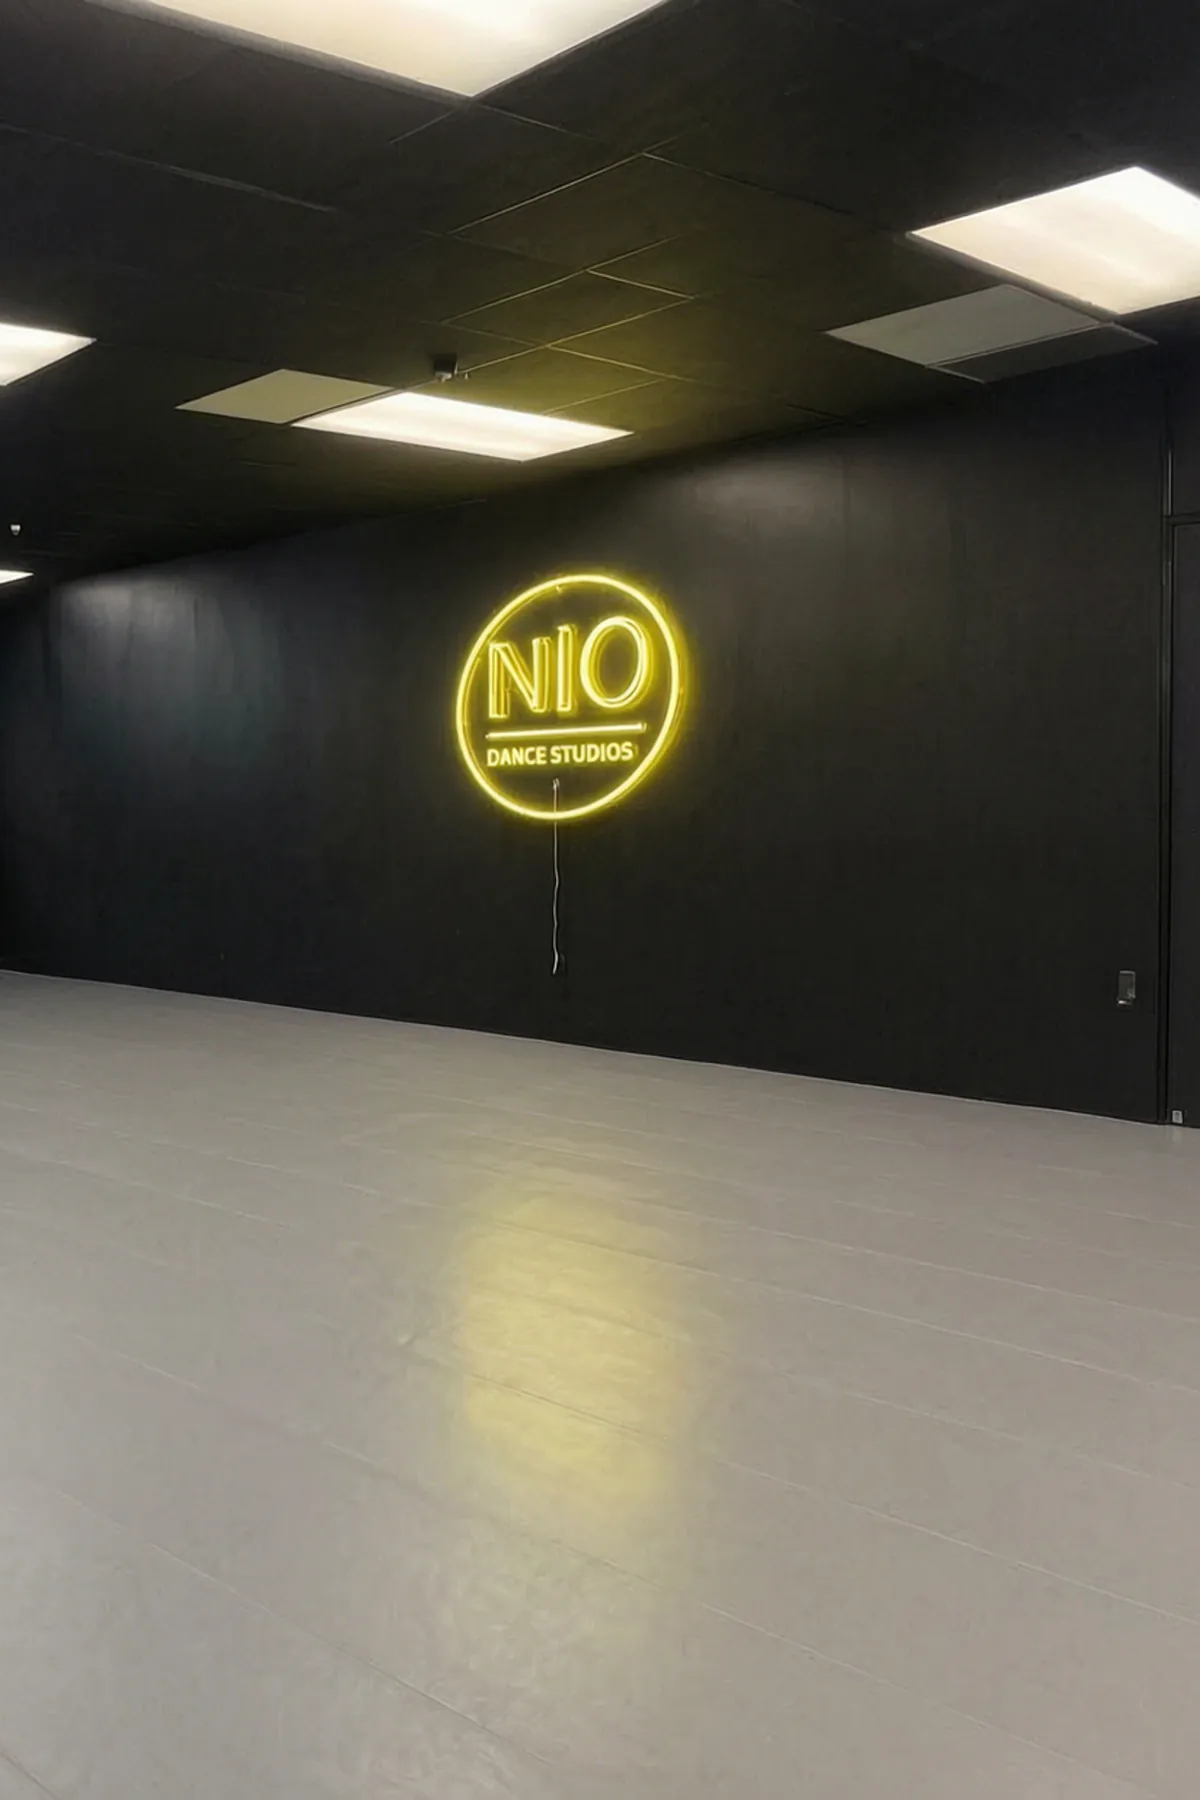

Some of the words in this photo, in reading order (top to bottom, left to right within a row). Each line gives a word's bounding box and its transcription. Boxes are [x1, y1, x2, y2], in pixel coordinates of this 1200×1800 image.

[488, 616, 650, 719] NIO
[486, 746, 547, 767] DANCE
[550, 741, 634, 764] STUDIOS
